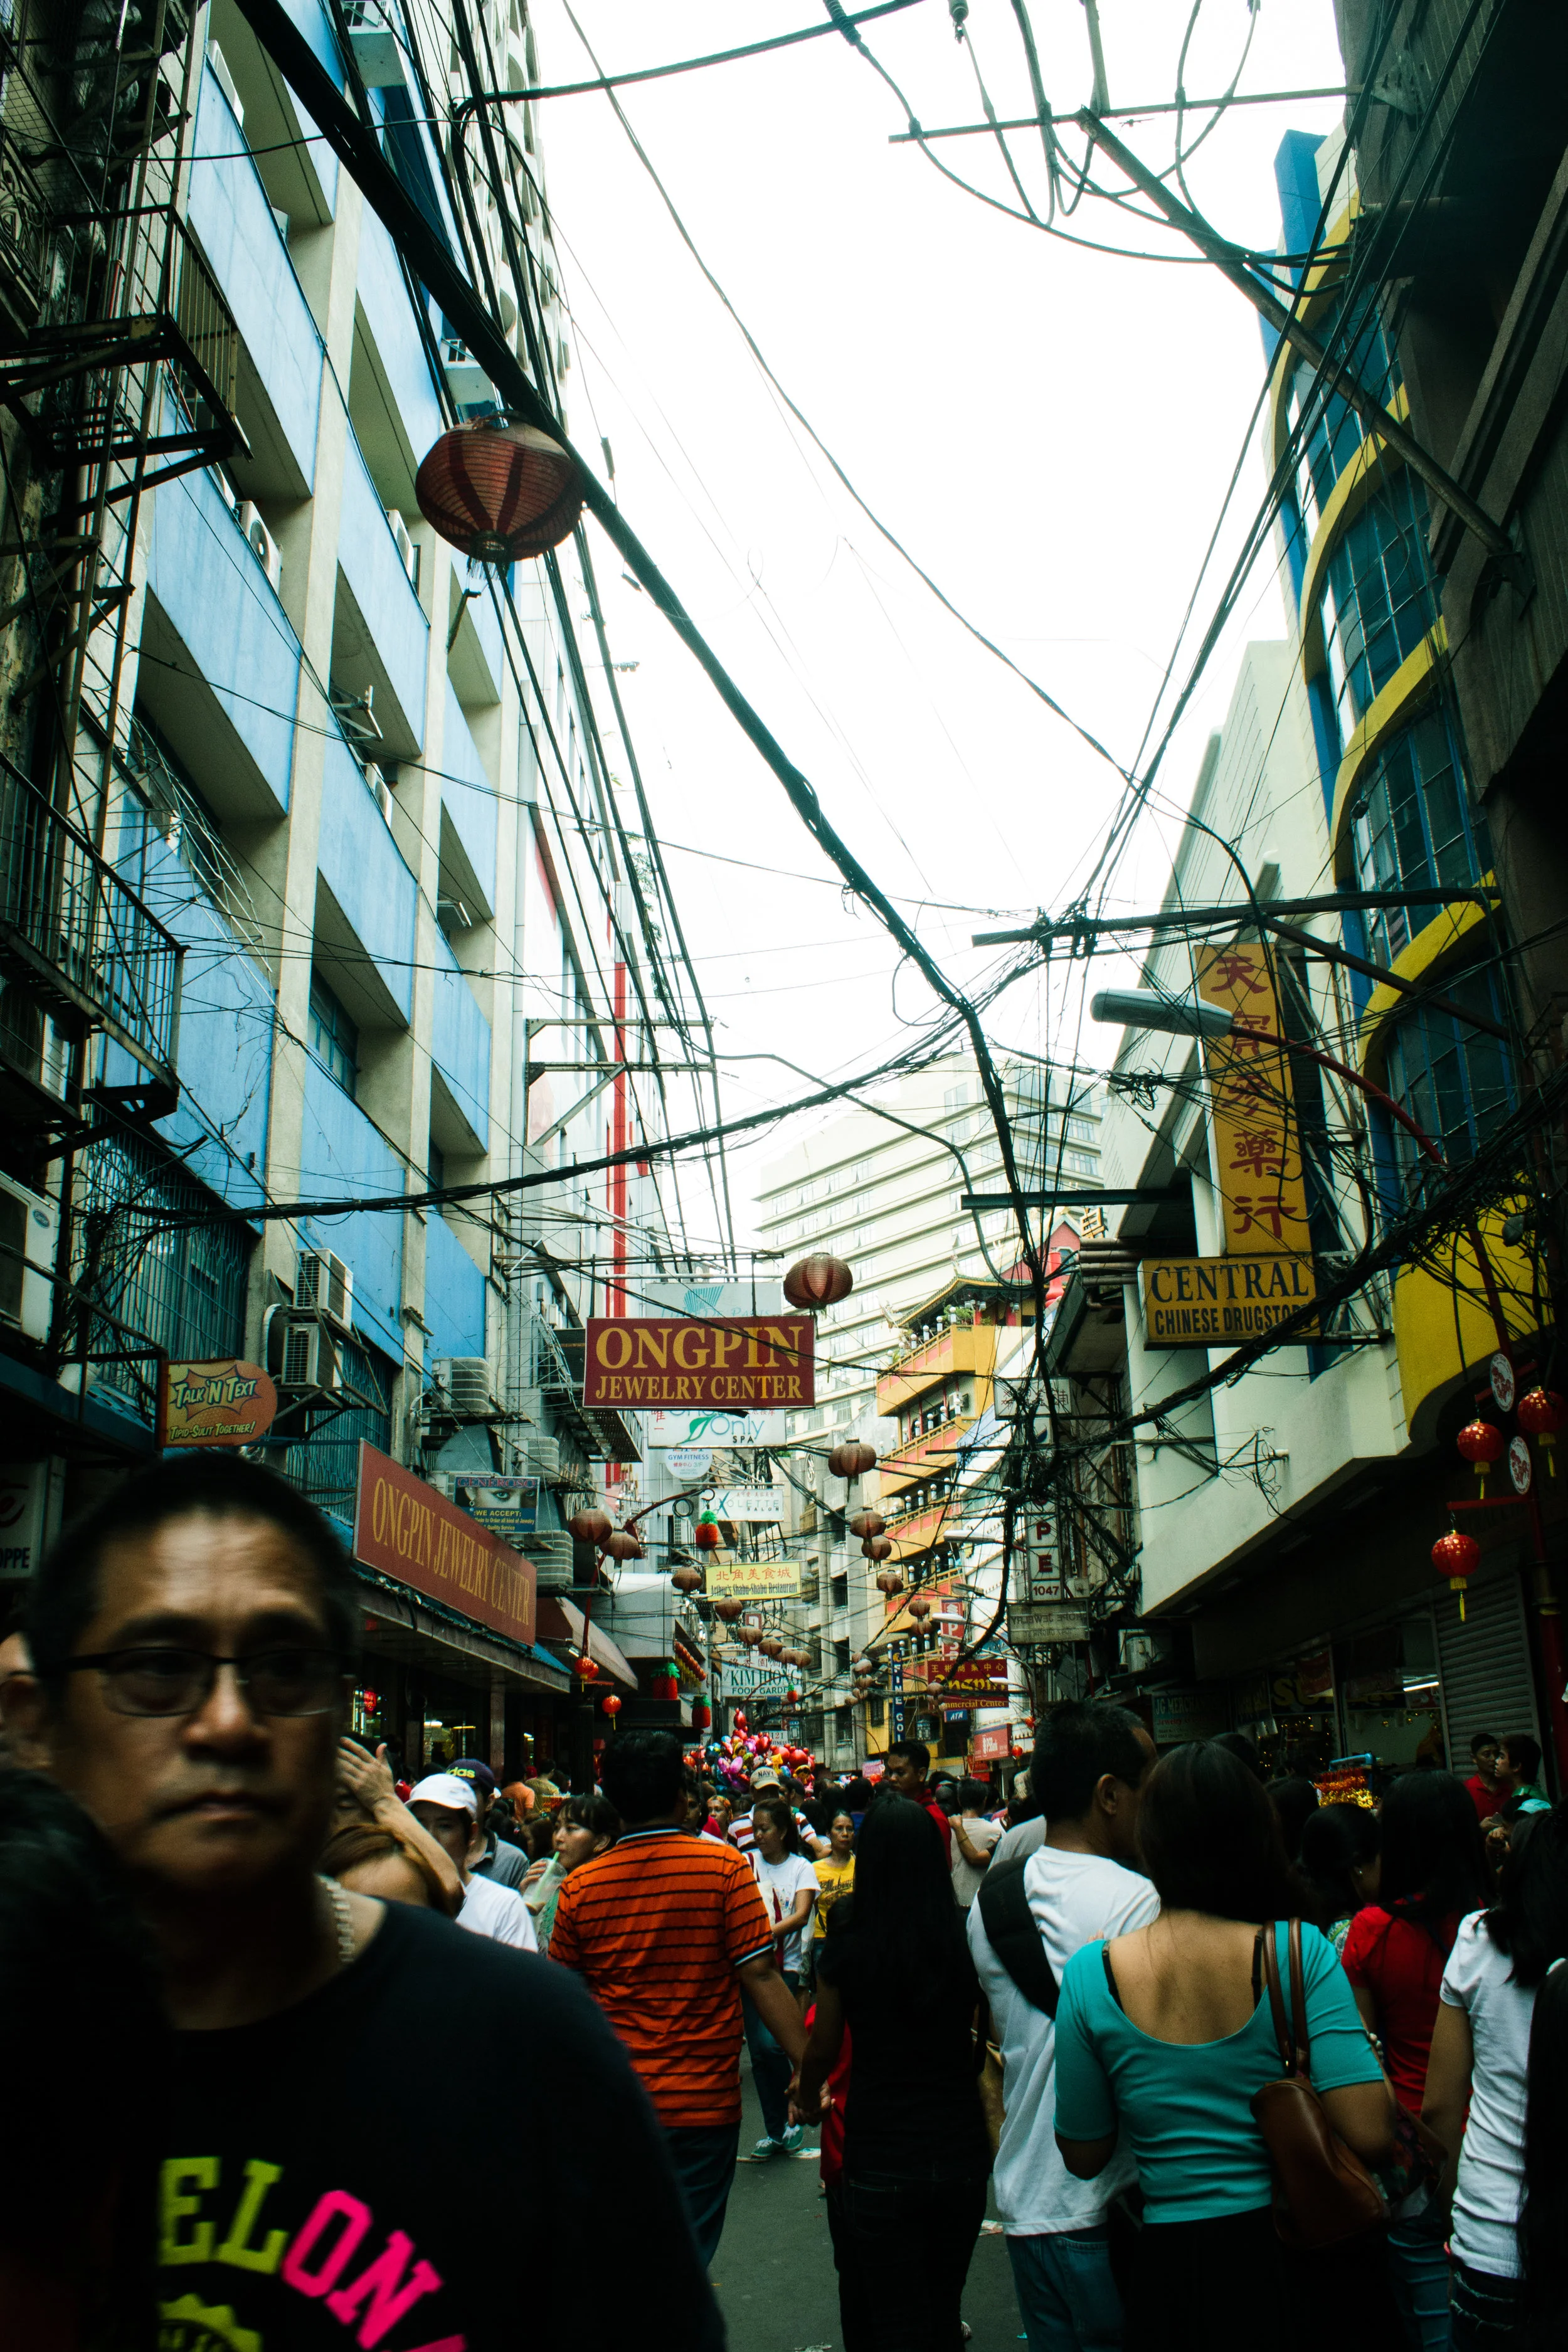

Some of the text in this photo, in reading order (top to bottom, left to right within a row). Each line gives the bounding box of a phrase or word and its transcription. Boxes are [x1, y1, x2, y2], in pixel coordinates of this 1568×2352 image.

[1151, 1262, 1309, 1303] CENTRAL
[1155, 1303, 1312, 1335] CHINESE DRUGSTO
[596, 1327, 804, 1369] ONGPIN
[596, 1375, 803, 1400] JEWELRY CENTER
[710, 1414, 765, 1439] Only
[733, 1435, 754, 1443] SPA
[457, 1478, 536, 1488] GENEROSO
[373, 1476, 530, 1626] ONGPIN JEWELRY CENTER
[716, 1567, 792, 1582] 北角美食城
[711, 1581, 798, 1597] Arthur's Shabu-Shabu Restaurant
[1033, 1586, 1059, 1596] 1047
[731, 1669, 755, 1686] KIM
[759, 1686, 789, 1694] GARDE
[893, 1663, 905, 1742] FINE GOL
[950, 1710, 964, 1722] ATM
[446, 1766, 475, 1779] das
